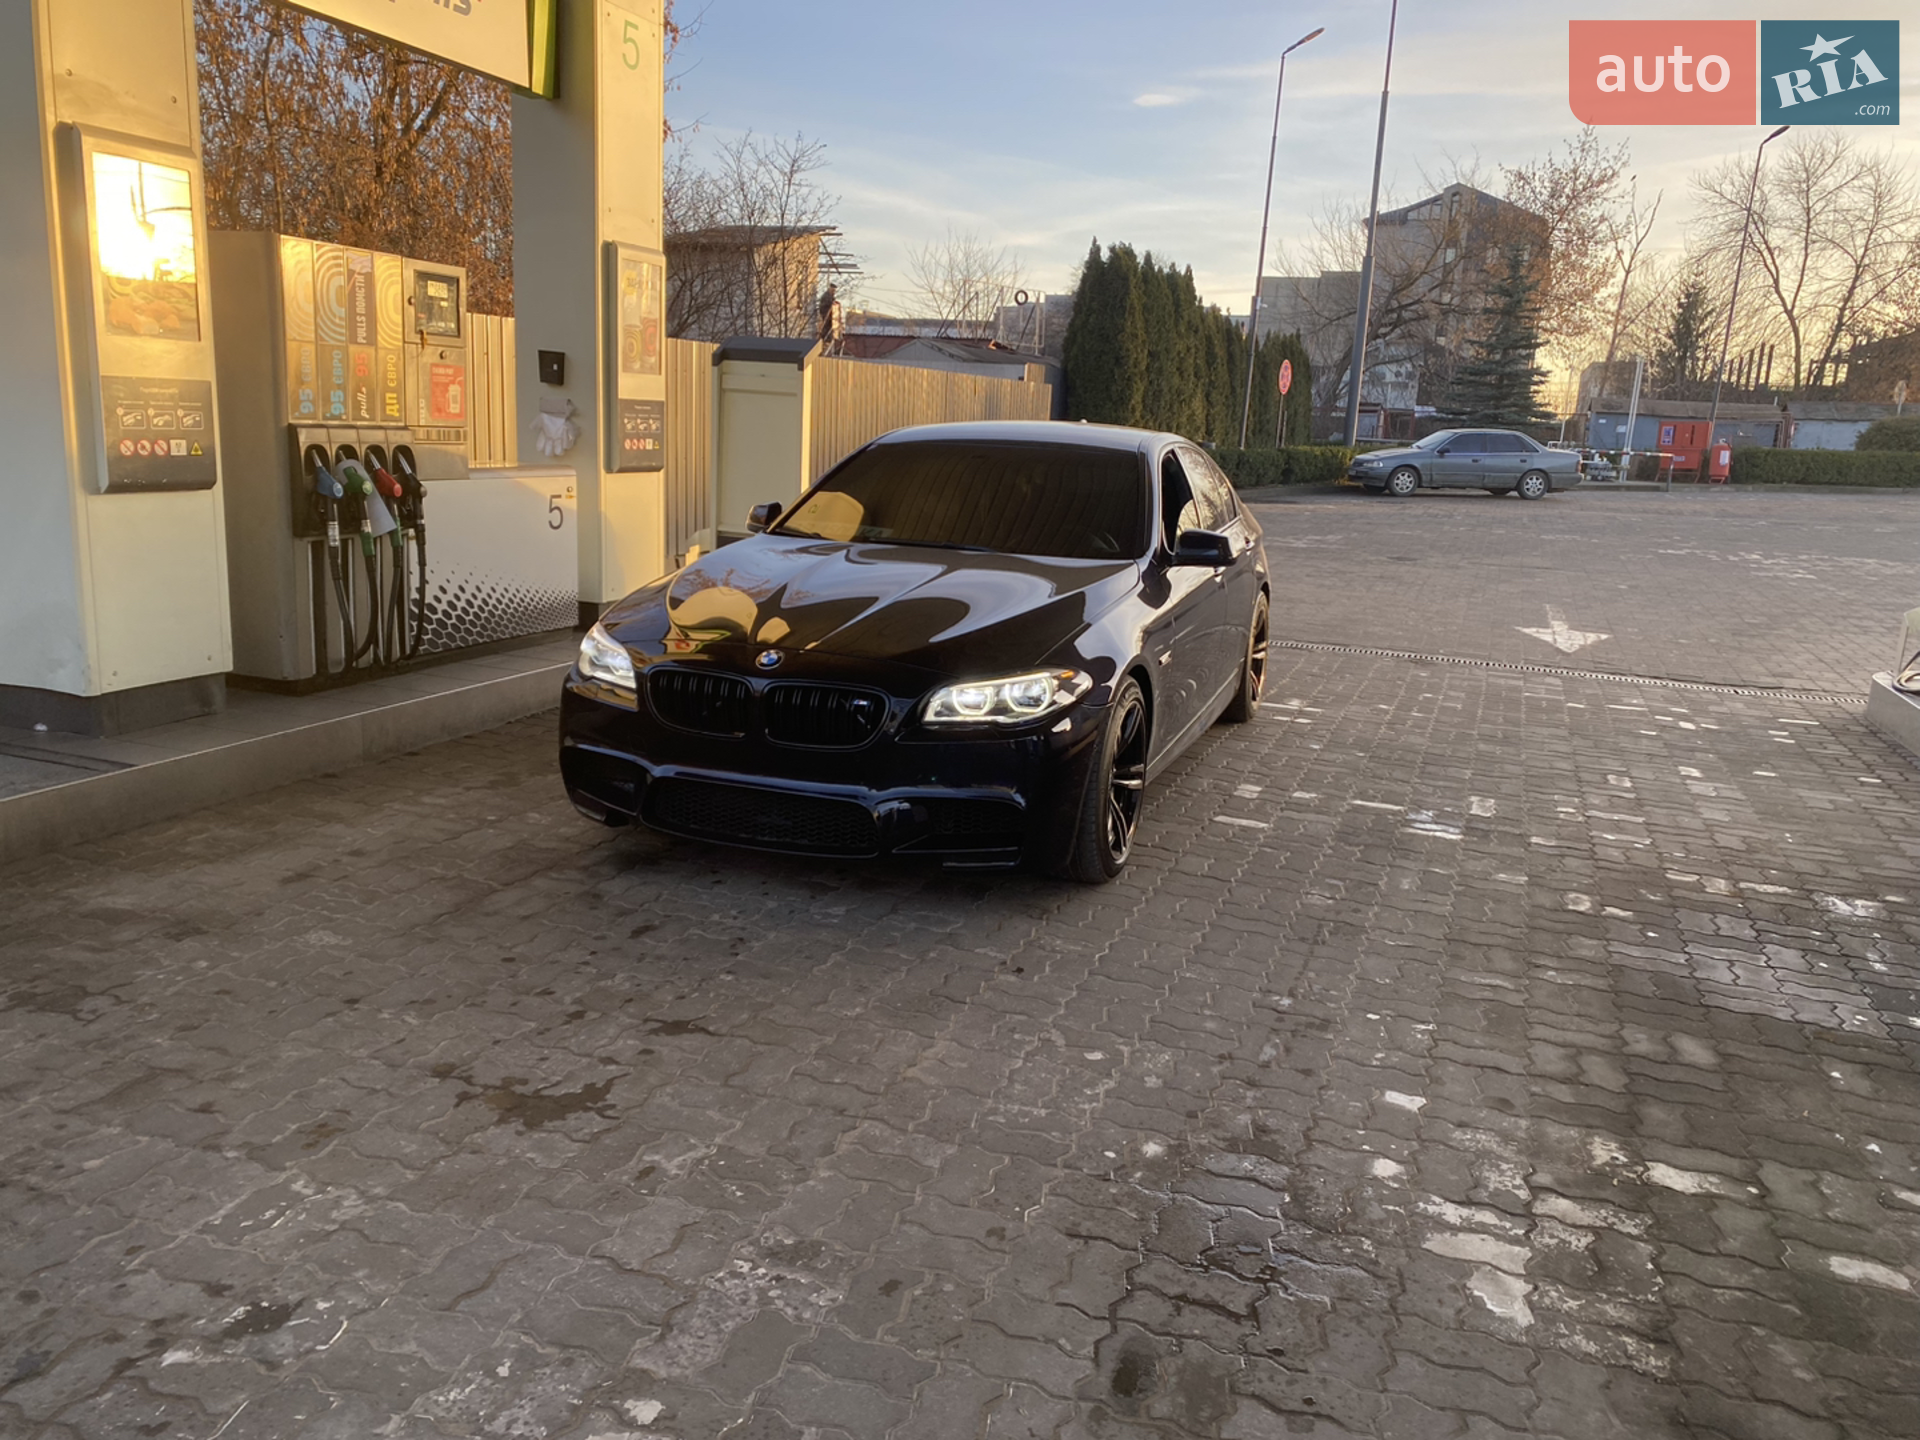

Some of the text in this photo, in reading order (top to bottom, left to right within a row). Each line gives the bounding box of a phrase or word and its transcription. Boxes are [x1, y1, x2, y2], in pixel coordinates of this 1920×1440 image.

[622, 20, 640, 70] 5
[356, 314, 368, 343] PULLS
[299, 346, 315, 414] 95 ЄВРО
[330, 349, 345, 416] 95 ЄВРО
[355, 352, 369, 377] 95
[385, 354, 400, 417] ДП ЄВРО
[548, 494, 564, 530] 5
